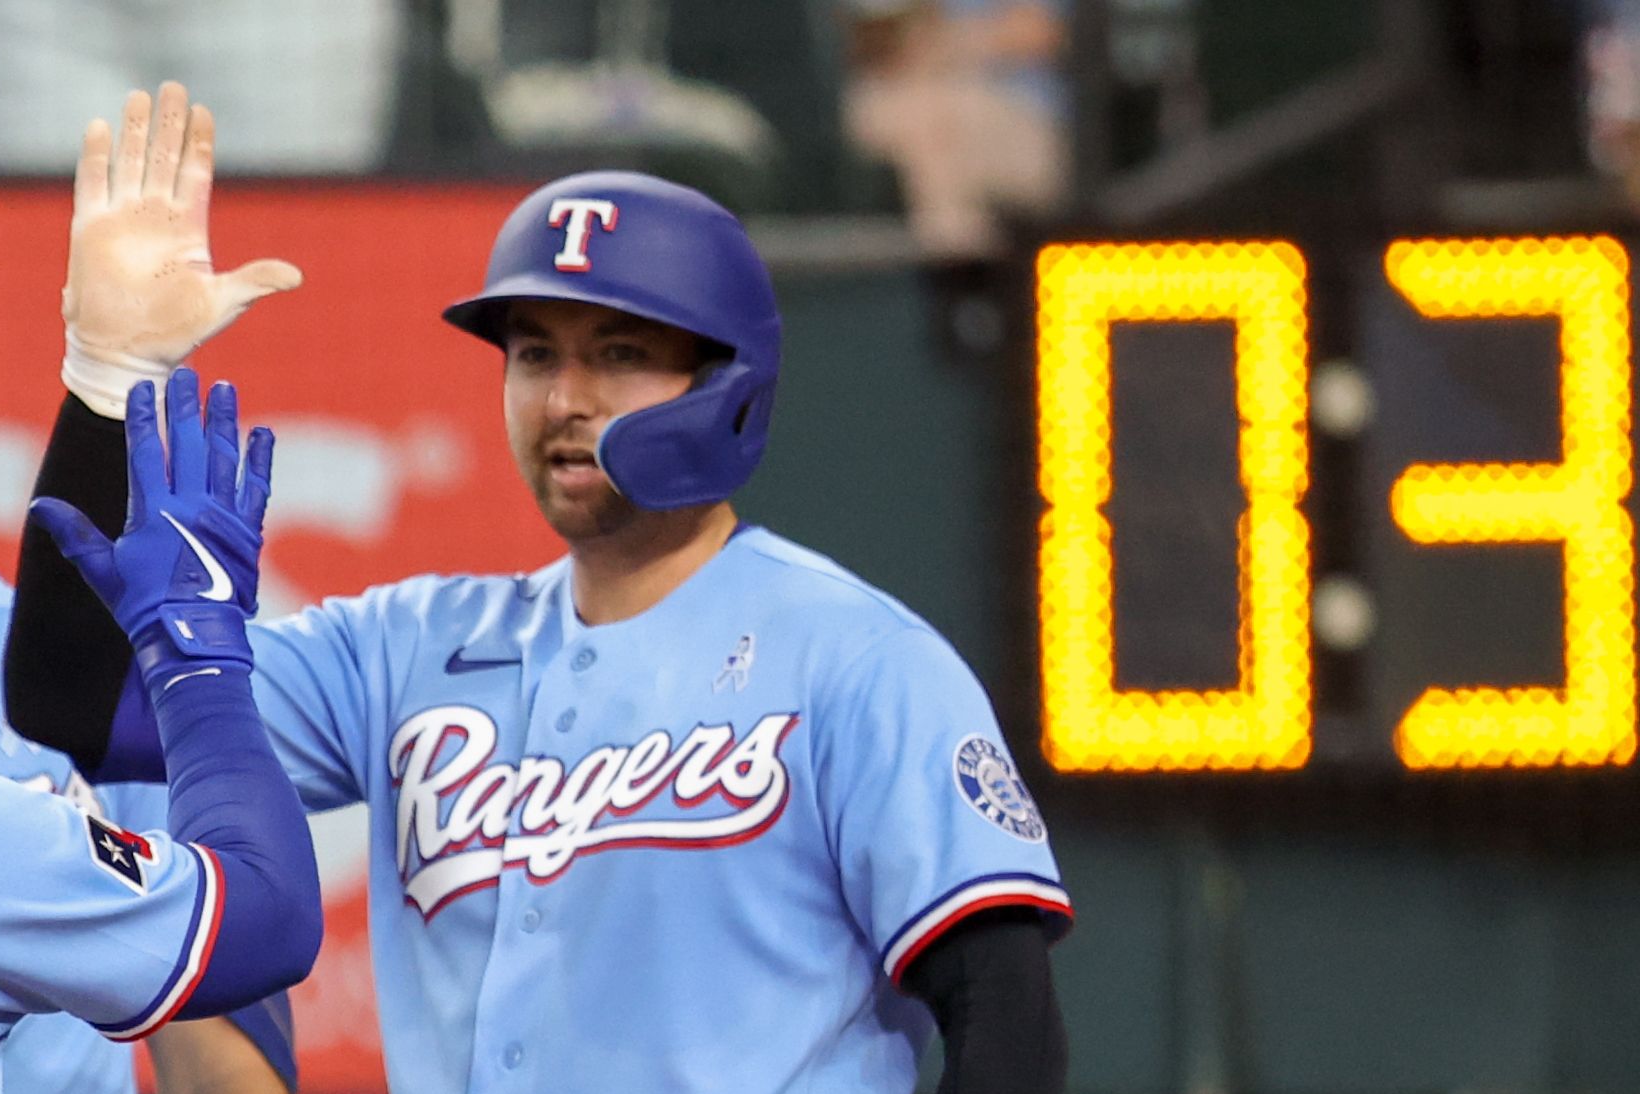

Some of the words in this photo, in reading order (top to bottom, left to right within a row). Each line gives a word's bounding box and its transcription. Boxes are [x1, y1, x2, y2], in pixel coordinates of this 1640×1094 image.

[548, 199, 619, 273] T
[1035, 234, 1637, 772] 03
[389, 705, 800, 924] Rangers
